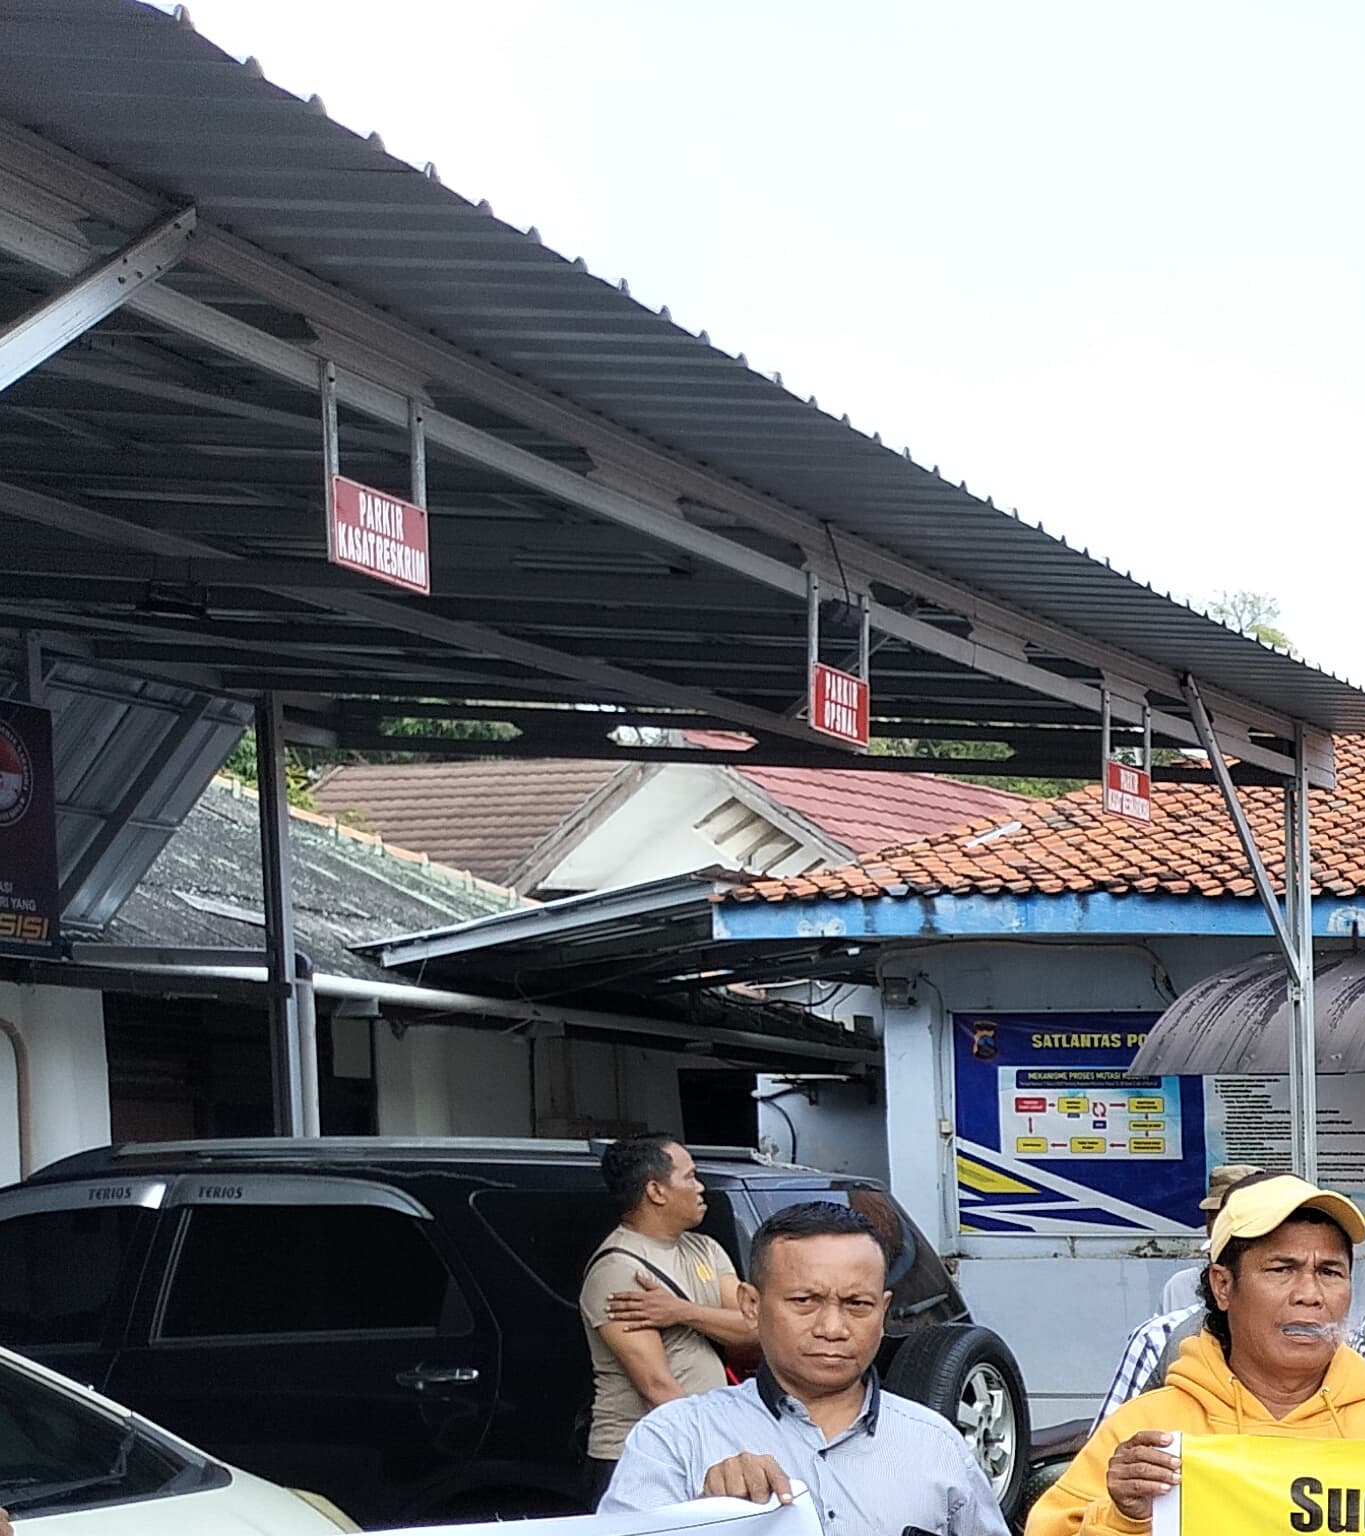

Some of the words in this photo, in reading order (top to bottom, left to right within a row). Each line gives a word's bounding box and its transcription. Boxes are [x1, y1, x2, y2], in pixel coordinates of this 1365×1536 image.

[359, 491, 404, 541] PARKIR
[825, 671, 858, 709] PARKIR
[10, 897, 37, 912] YANG
[1031, 1033, 1122, 1049] SATLANTAS
[88, 1187, 132, 1200] TERIOS
[198, 1186, 244, 1199] TERIOS
